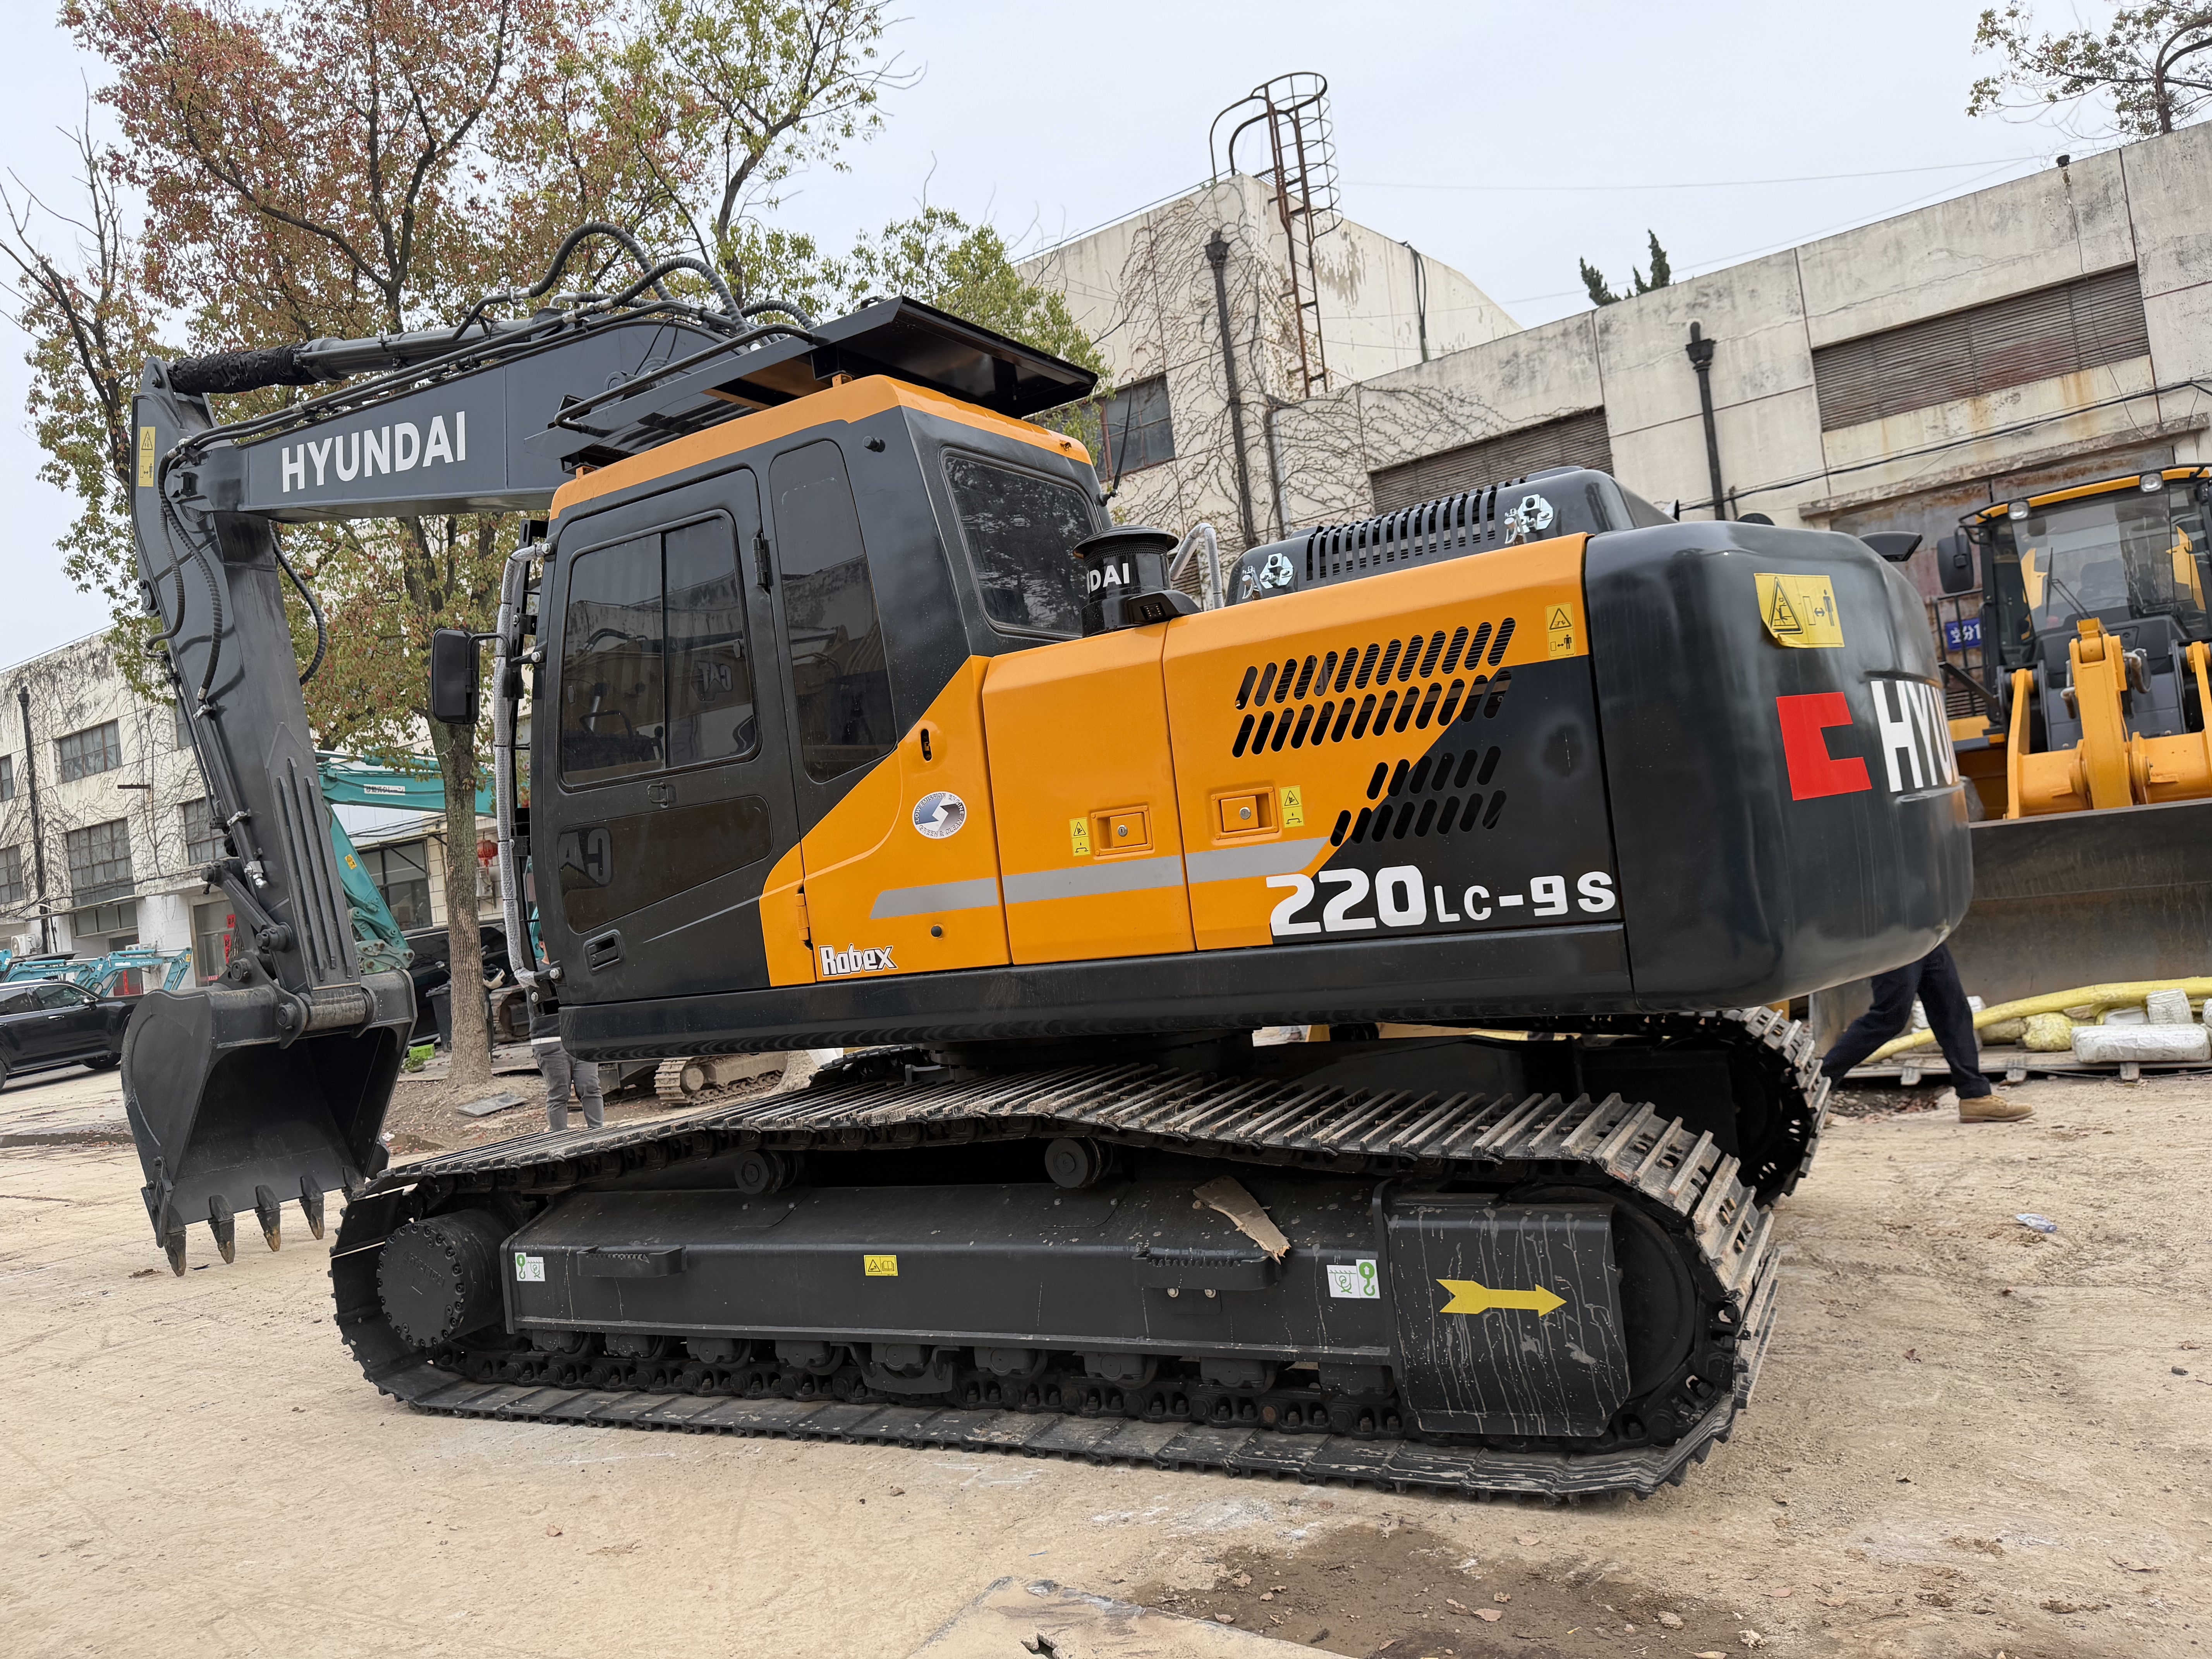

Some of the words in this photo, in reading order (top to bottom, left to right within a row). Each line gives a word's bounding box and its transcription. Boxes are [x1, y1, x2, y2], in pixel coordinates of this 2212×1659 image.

[282, 410, 465, 493] HYUNDAI
[1870, 680, 1960, 793] HYU
[920, 793, 946, 807] EMISSION
[919, 825, 938, 837] GREEN
[946, 818, 963, 835] CLEAN
[819, 943, 898, 976] Robex
